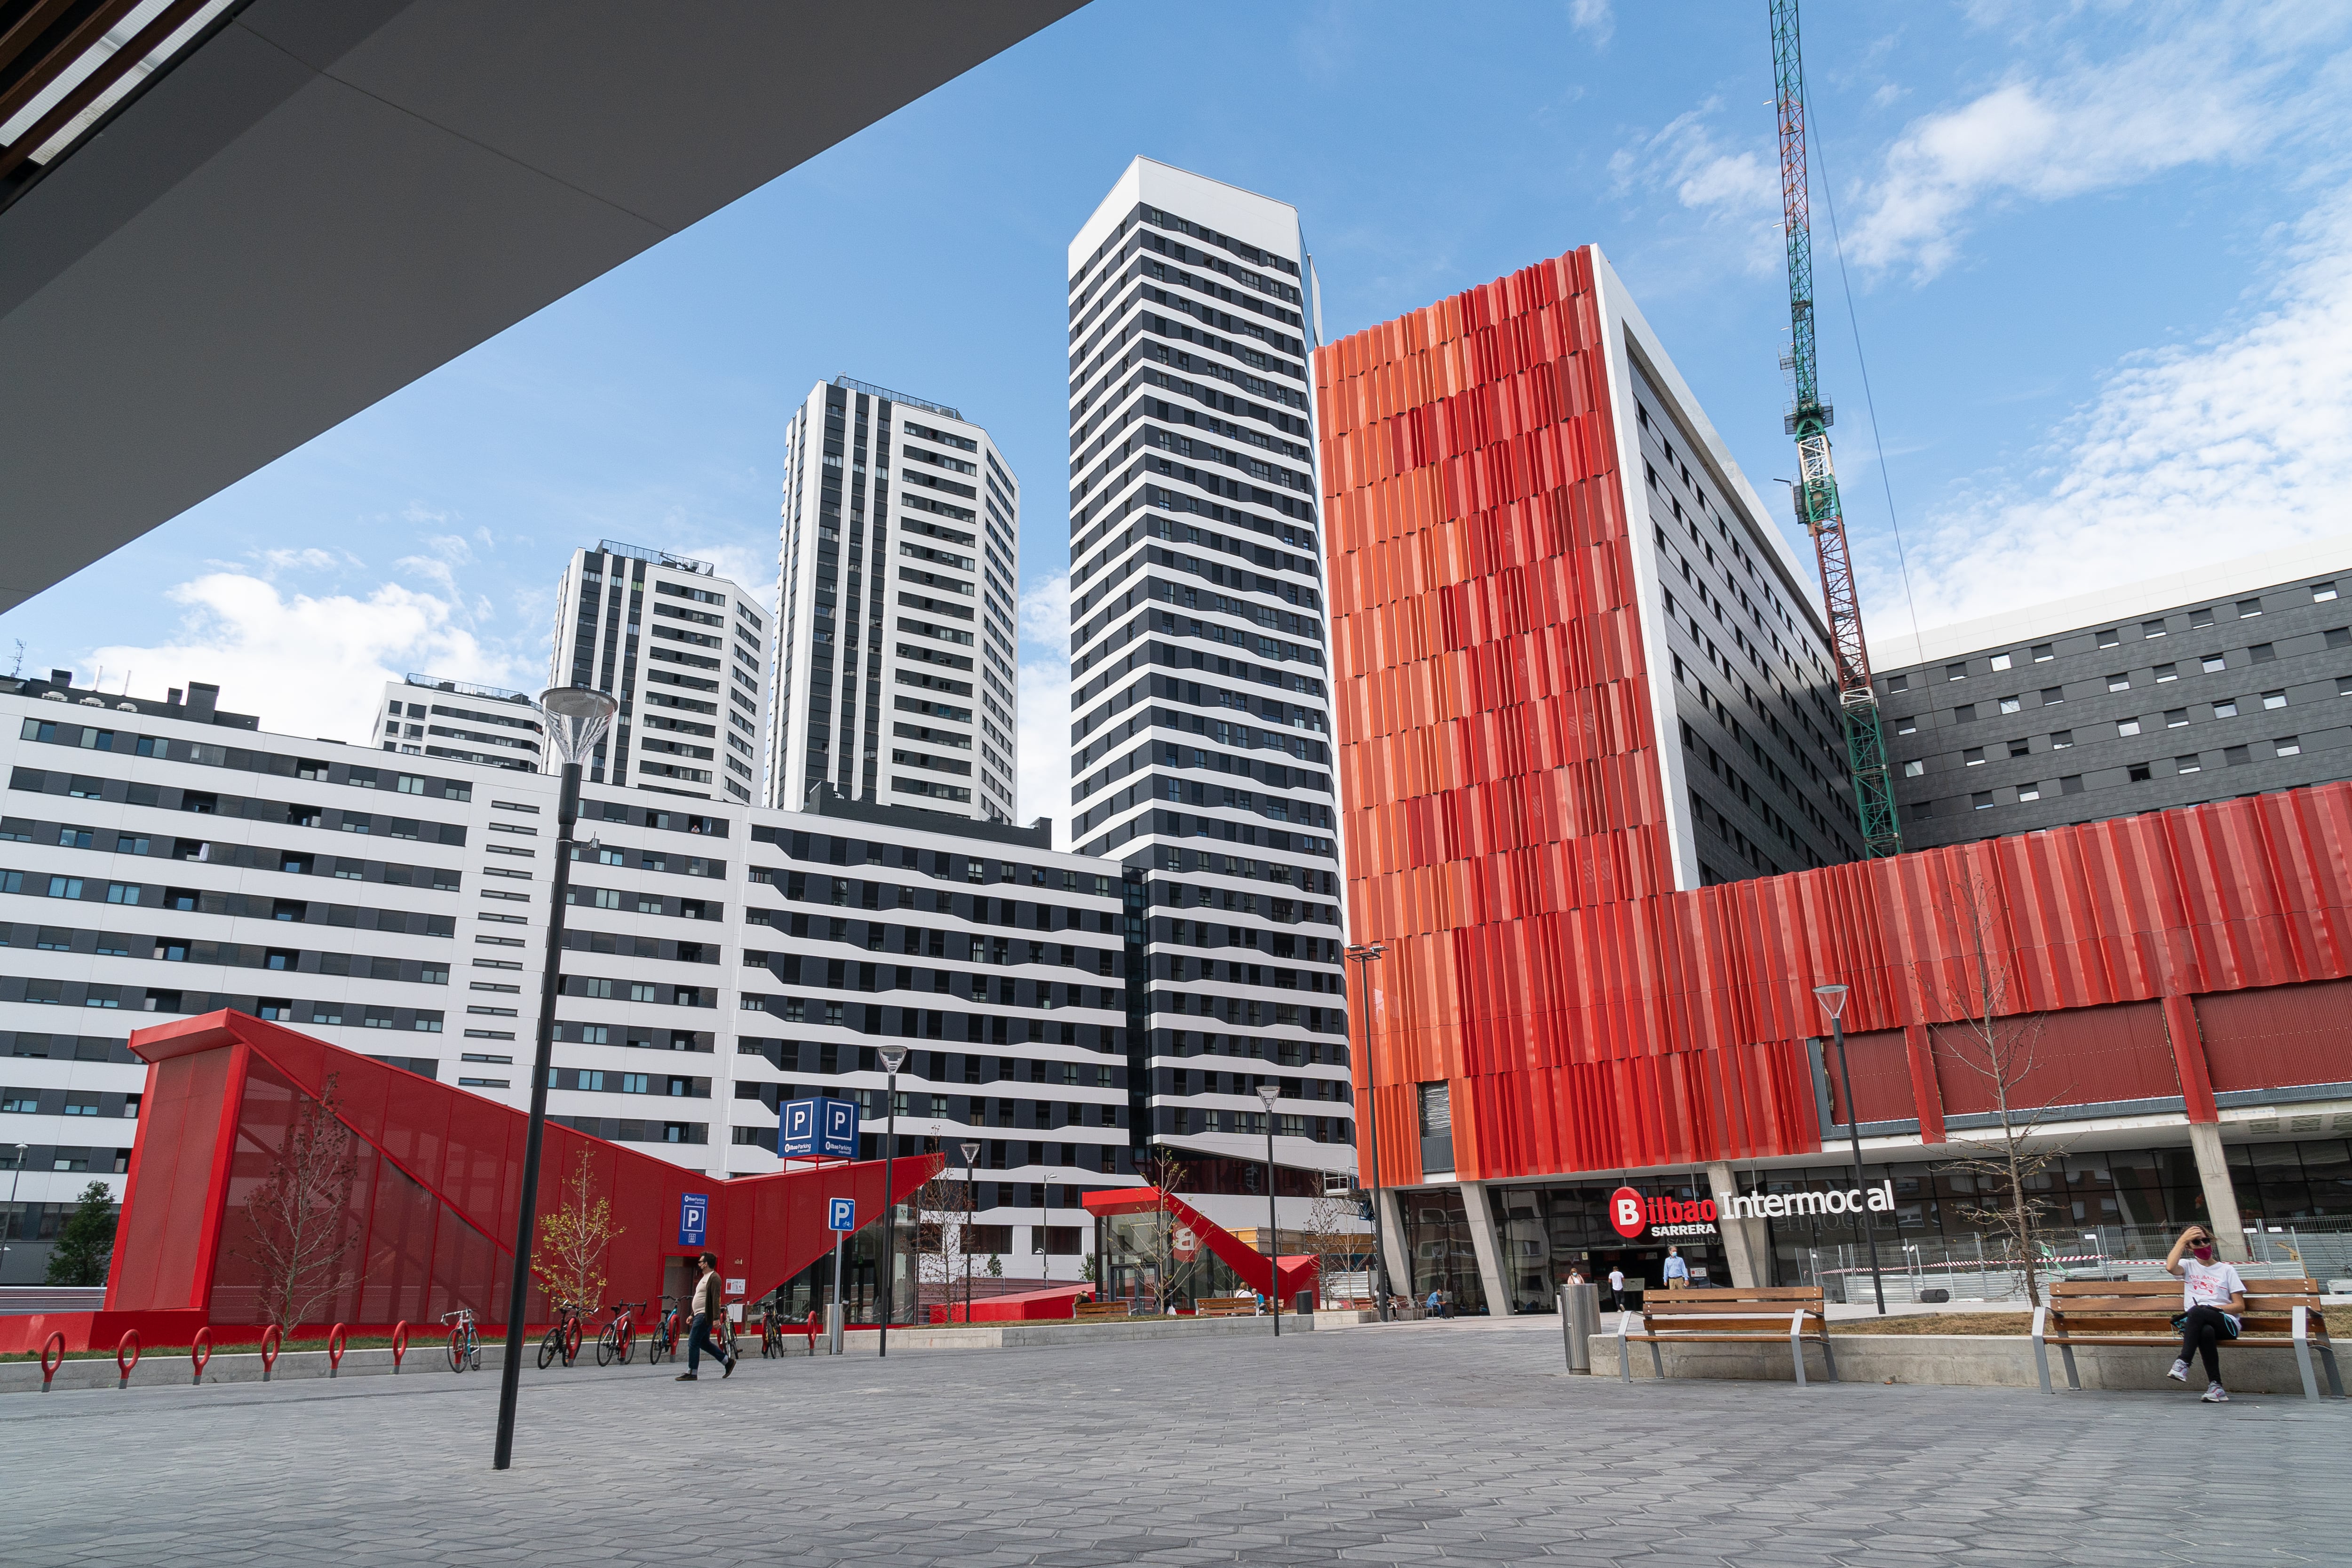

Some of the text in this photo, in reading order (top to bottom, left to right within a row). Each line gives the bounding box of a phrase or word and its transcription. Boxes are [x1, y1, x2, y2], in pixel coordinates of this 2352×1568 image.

[794, 1111, 805, 1131] P
[834, 1111, 846, 1130] P
[826, 1141, 839, 1150] Bilbao
[688, 1210, 699, 1227] P
[834, 1202, 850, 1226] P
[1617, 1195, 1717, 1226] Bilbao
[1651, 1223, 1717, 1237] SARRERA
